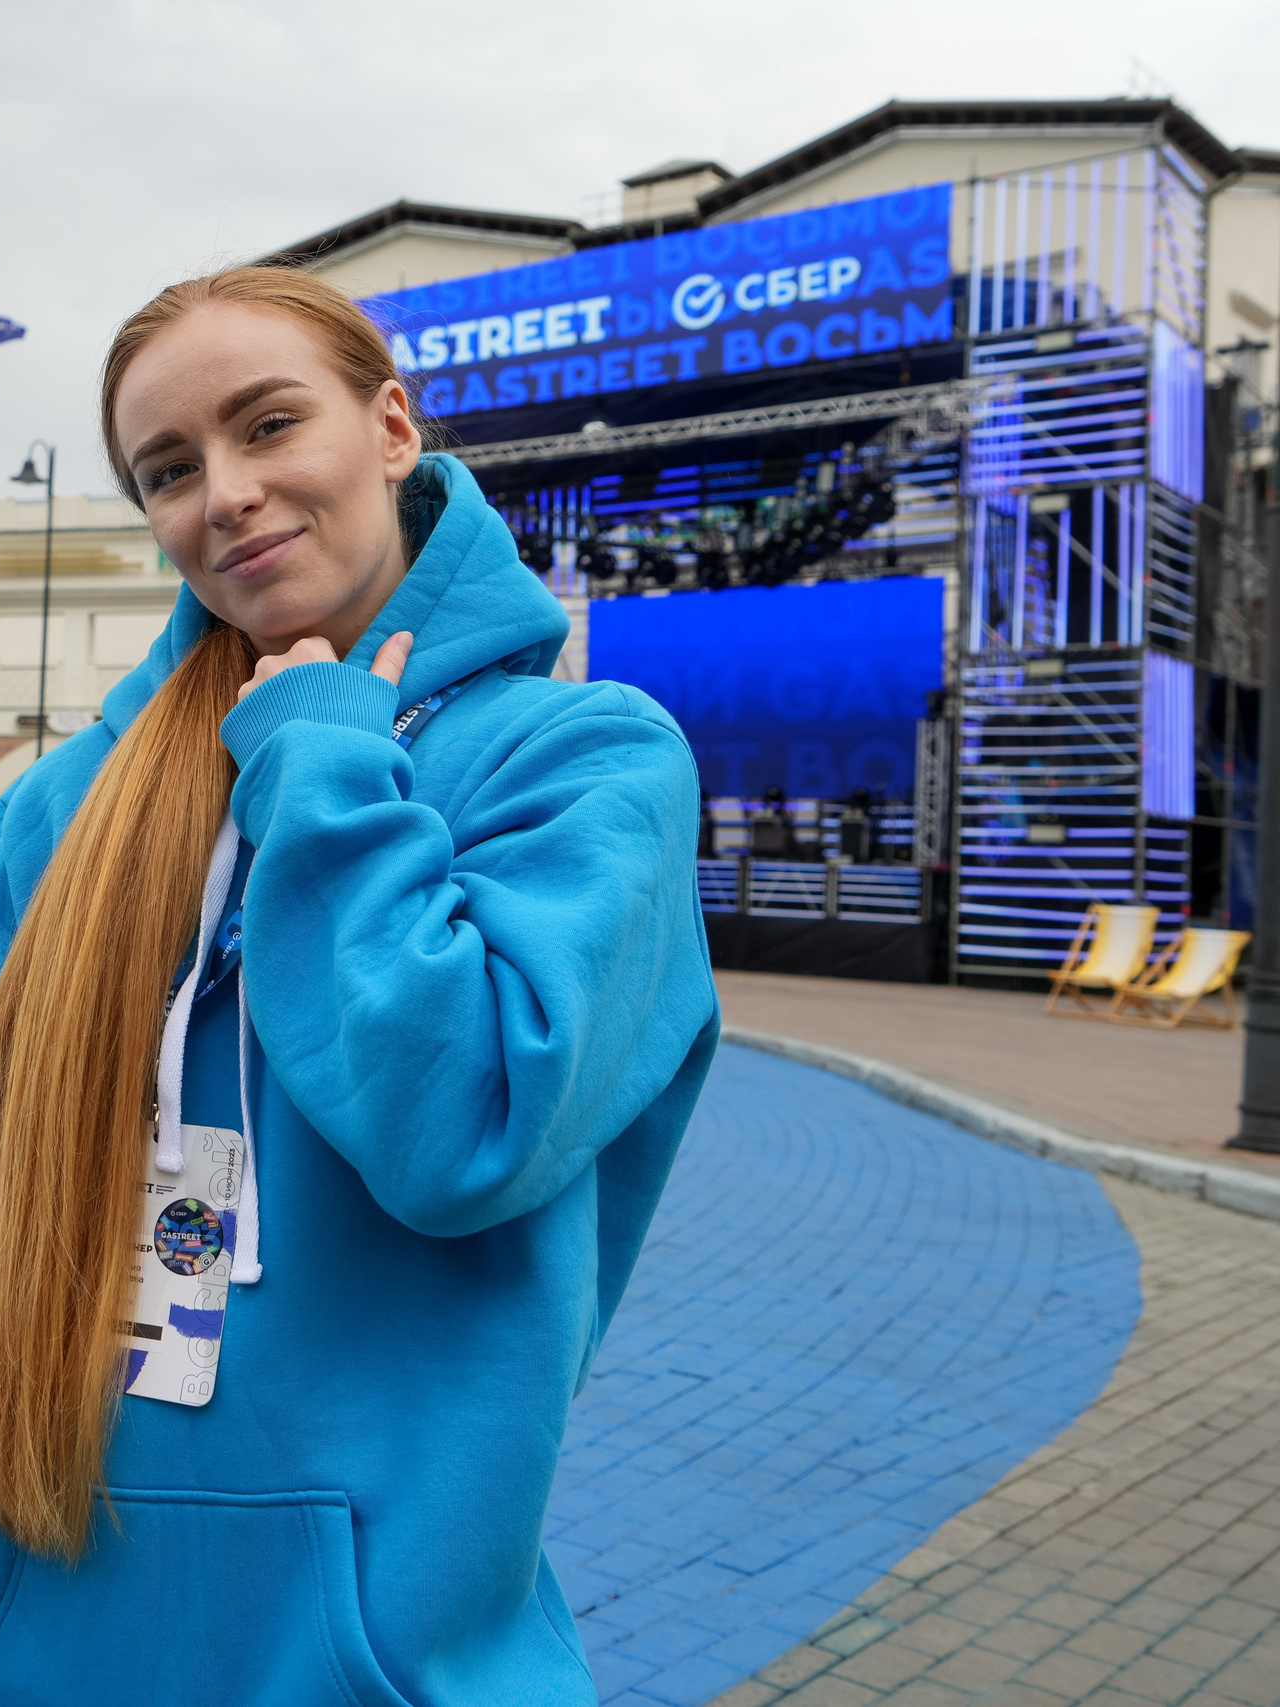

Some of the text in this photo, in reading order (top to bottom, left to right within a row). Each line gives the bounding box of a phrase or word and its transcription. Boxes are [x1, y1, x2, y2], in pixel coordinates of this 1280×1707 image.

[734, 256, 862, 312] СБЕР
[391, 295, 612, 372] ASTREET
[422, 336, 708, 420] GASTREET
[228, 1148, 236, 1167] 2023
[161, 1231, 202, 1241] GASTREET
